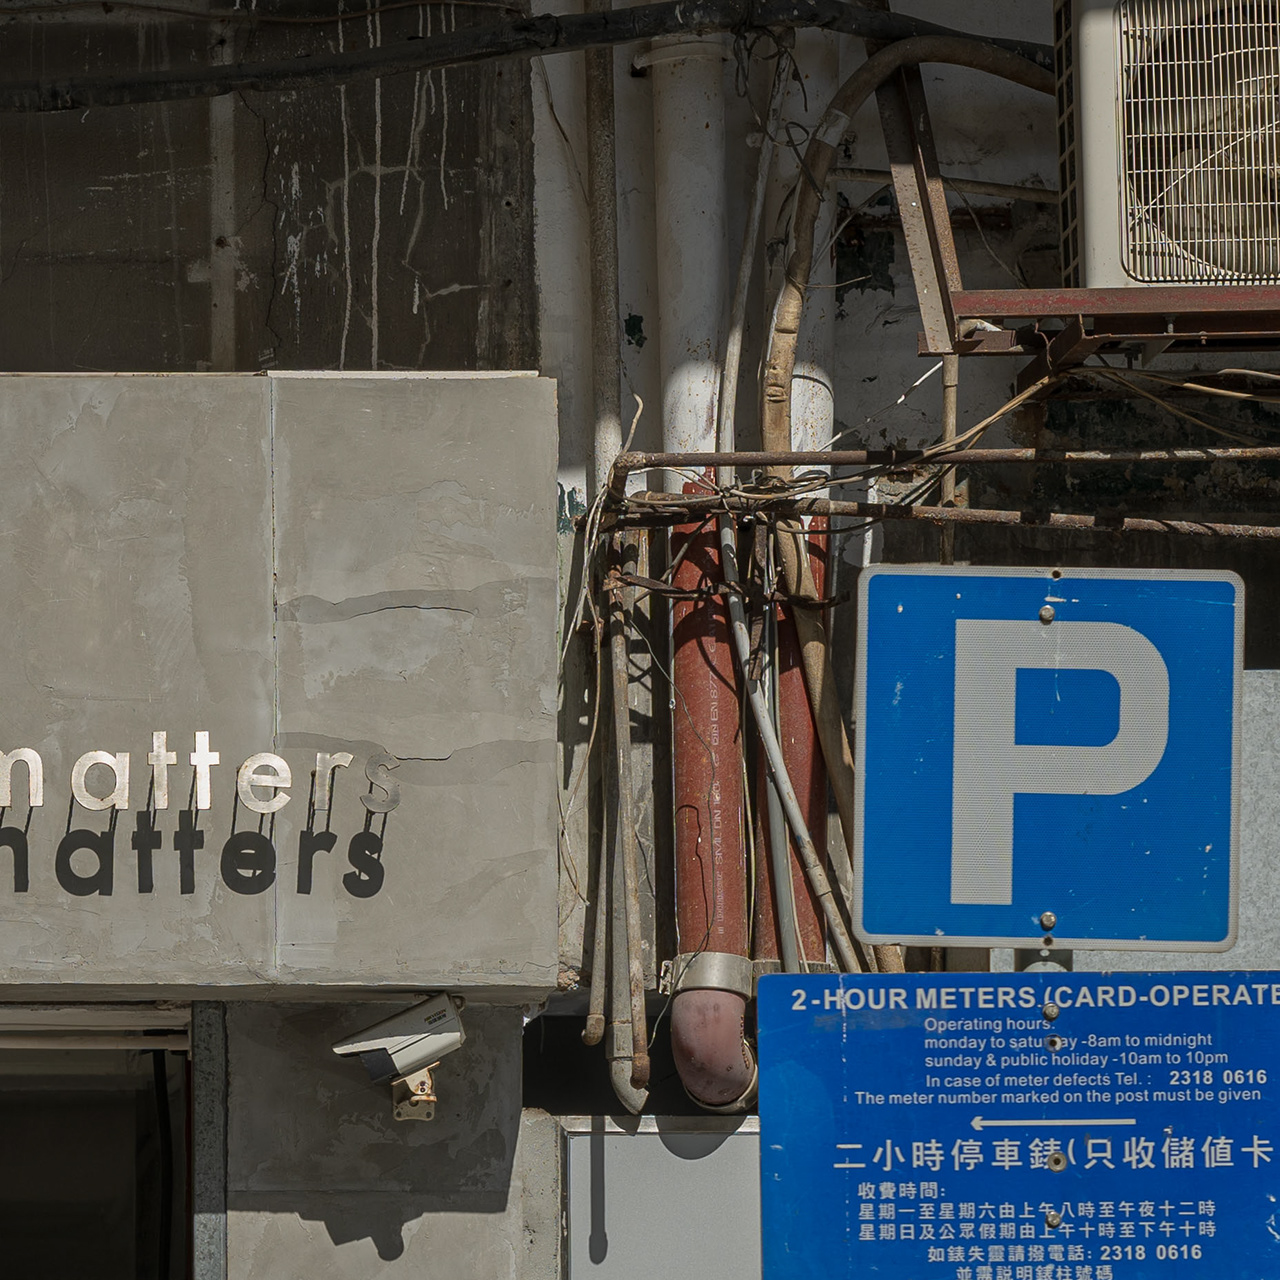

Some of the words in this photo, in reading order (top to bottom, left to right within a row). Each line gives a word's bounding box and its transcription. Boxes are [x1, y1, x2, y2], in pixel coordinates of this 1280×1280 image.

[950, 618, 1170, 905] P
[791, 988, 908, 1011] 2-HOUR
[916, 986, 1036, 1010] METERS
[924, 1016, 1003, 1033] Operating
[924, 1035, 987, 1052] monday
[990, 1035, 1006, 1049] to
[1009, 1034, 1078, 1051] satuay
[1081, 1034, 1121, 1048] -8am
[1125, 1034, 1141, 1047] to
[1144, 1032, 1213, 1050] midnight
[924, 1052, 982, 1069] sunday
[985, 1052, 997, 1067] &
[1001, 1051, 1049, 1069] public
[1052, 1050, 1109, 1068] holiday
[1112, 1050, 1163, 1065] -10am
[1166, 1050, 1182, 1065] to
[1186, 1049, 1229, 1067] 10pm
[926, 1073, 940, 1088] In
[944, 1075, 982, 1088] case
[985, 1072, 1001, 1087] of
[1004, 1073, 1050, 1087] meter
[1052, 1071, 1111, 1087] defects
[1169, 1070, 1214, 1086] 2318
[1222, 1069, 1268, 1085] 0616
[855, 1090, 885, 1104] The
[888, 1091, 934, 1104] meter
[938, 1088, 998, 1103] number
[1001, 1089, 1060, 1104] marked
[1063, 1089, 1083, 1103] on
[1086, 1088, 1112, 1103] the
[1115, 1088, 1150, 1105] post
[1153, 1086, 1192, 1102] must
[1195, 1086, 1215, 1101] be
[1218, 1086, 1262, 1104] given
[858, 1200, 1217, 1221] 星期一至星期六由上午八時至午夜十二時
[1099, 1245, 1147, 1261] 2318
[1156, 1244, 1203, 1260] 0616
